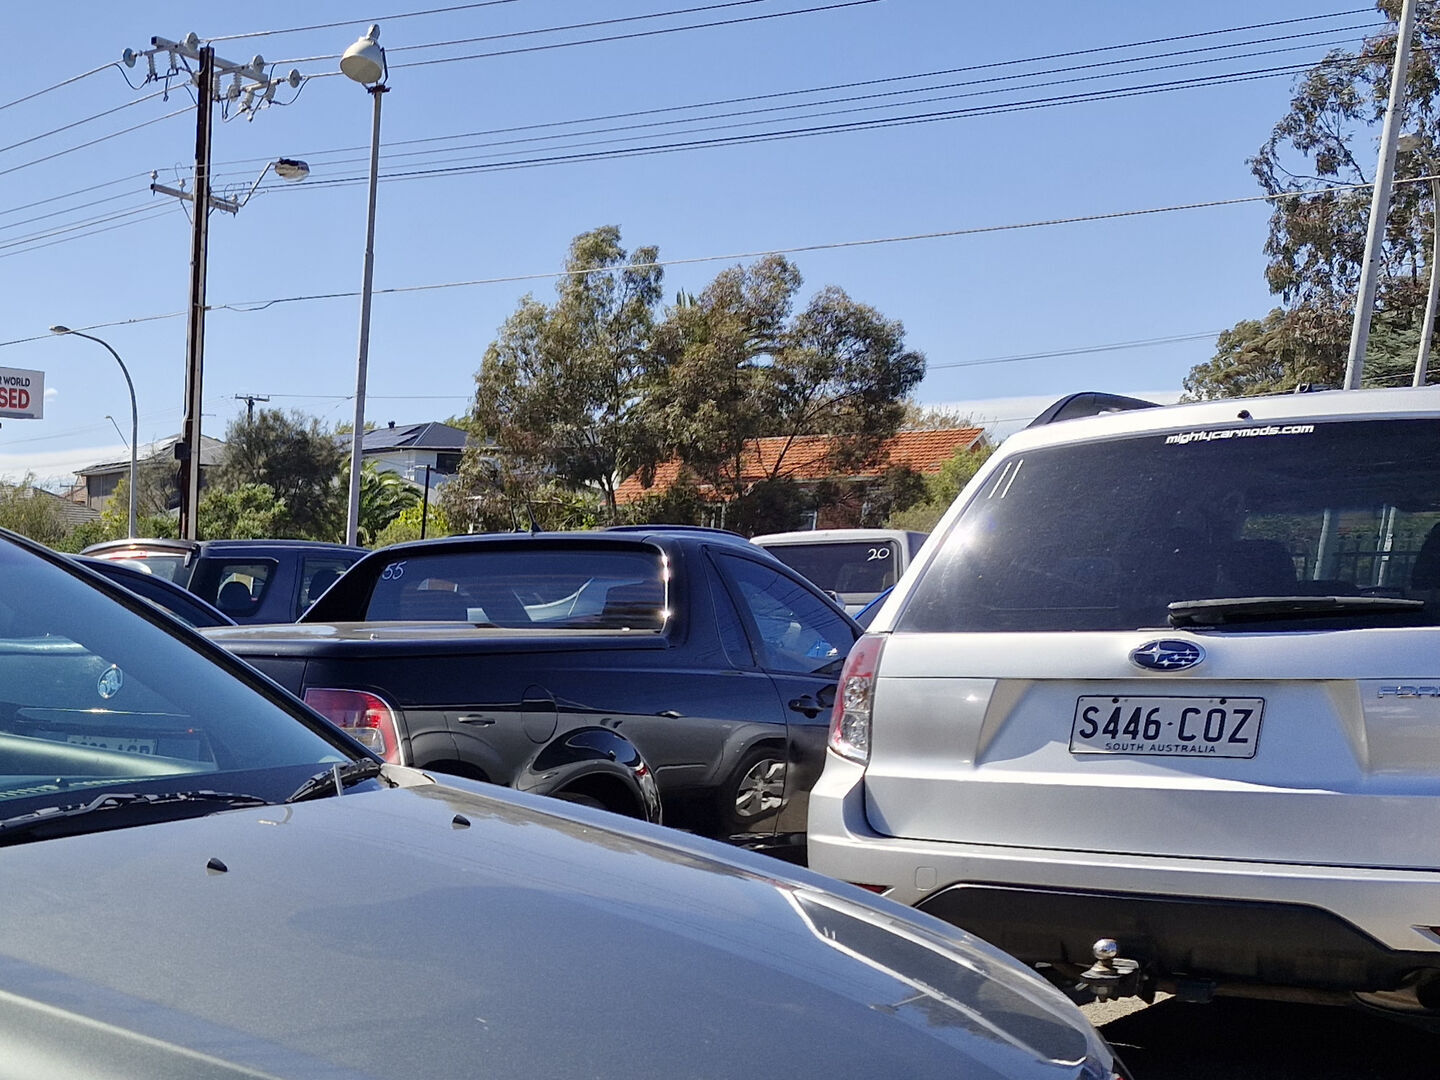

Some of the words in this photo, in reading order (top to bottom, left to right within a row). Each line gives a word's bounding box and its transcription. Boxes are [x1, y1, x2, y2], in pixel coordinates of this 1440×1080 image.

[3, 376, 30, 387] WORLD
[1164, 424, 1314, 445] mightycarmods.com
[867, 547, 890, 562] 20
[382, 560, 408, 580] 55
[1104, 742, 1145, 752] SOUTH
[1148, 742, 1217, 754] AUSTRALIA
